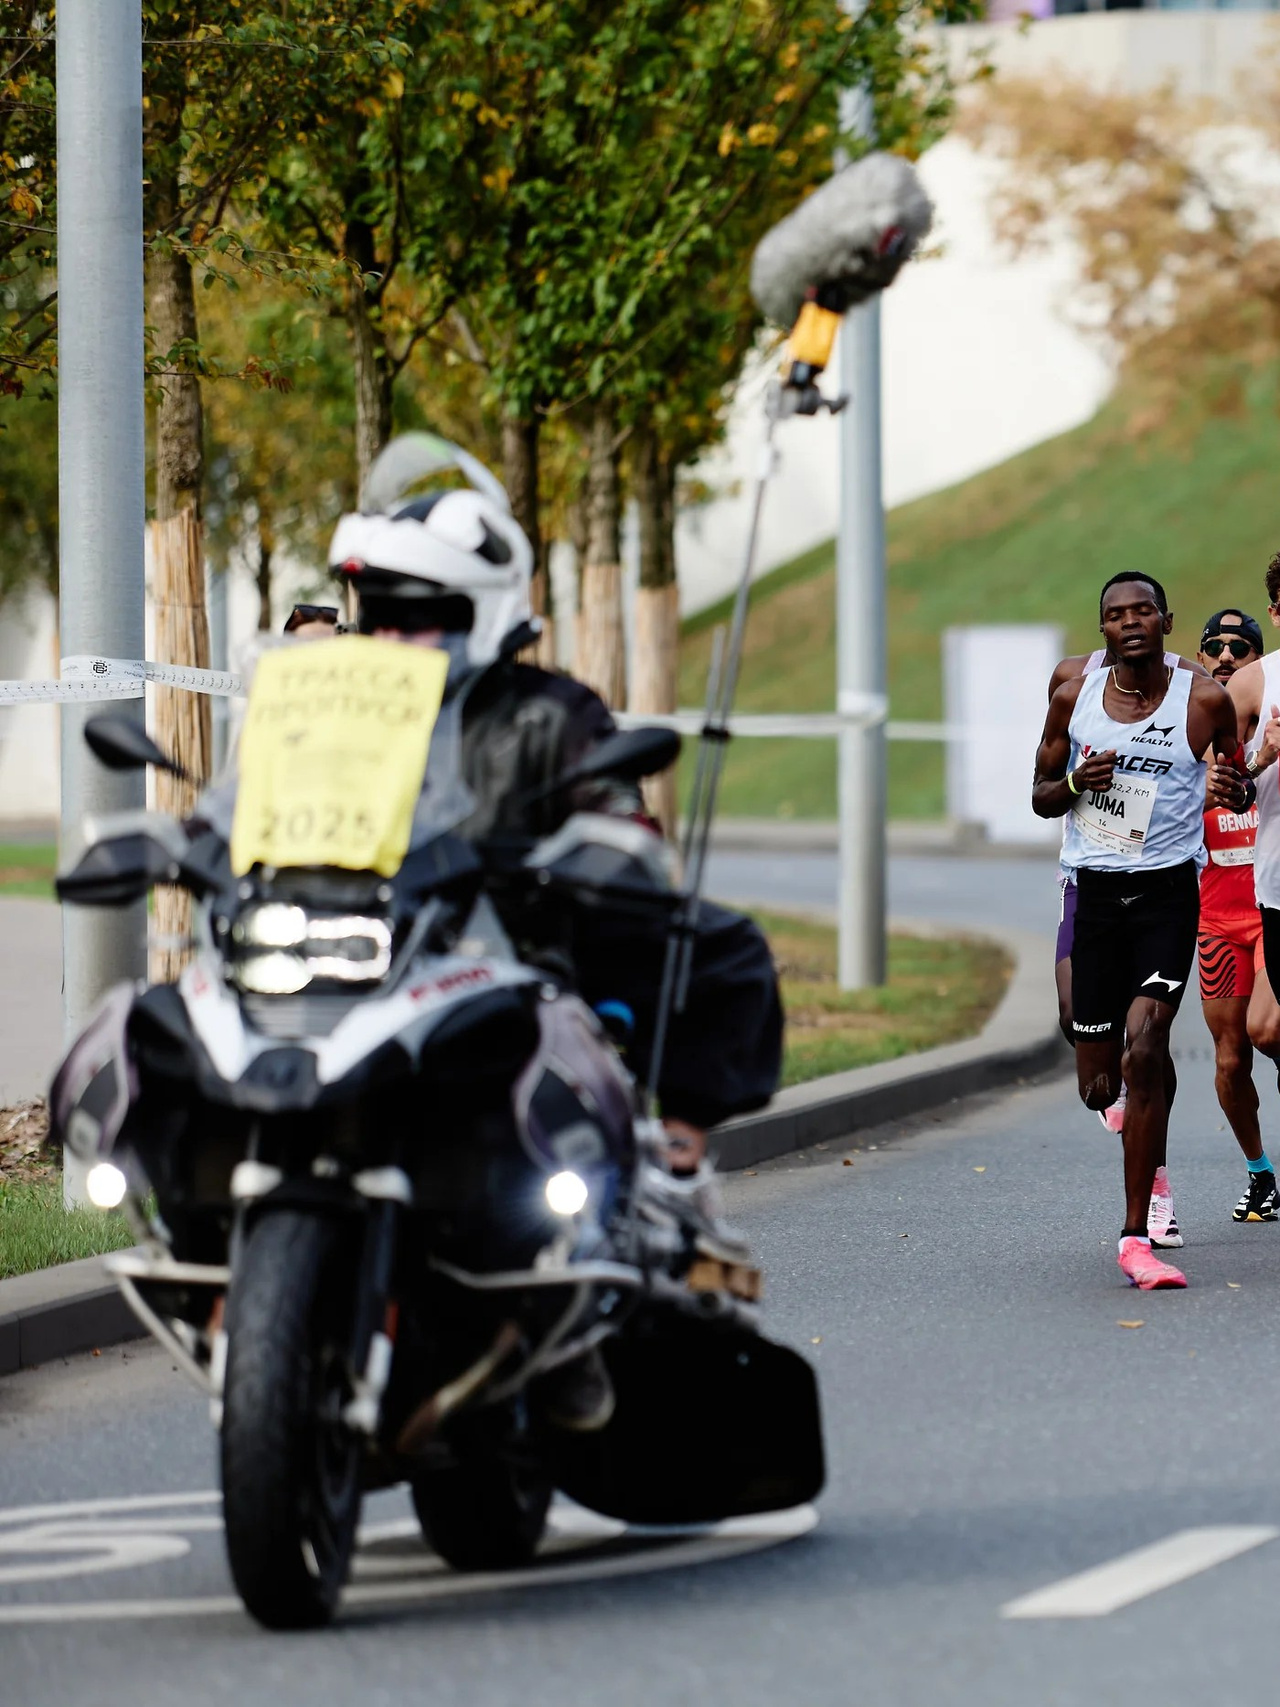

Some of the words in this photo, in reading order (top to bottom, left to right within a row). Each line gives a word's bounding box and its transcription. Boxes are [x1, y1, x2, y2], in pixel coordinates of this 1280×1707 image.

[1131, 736, 1173, 748] HEALTH
[1111, 783, 1132, 794] 42,2
[1134, 789, 1150, 798] KM
[1088, 792, 1125, 819] JUMA
[258, 804, 376, 844] 2025
[1098, 819, 1107, 827] 14
